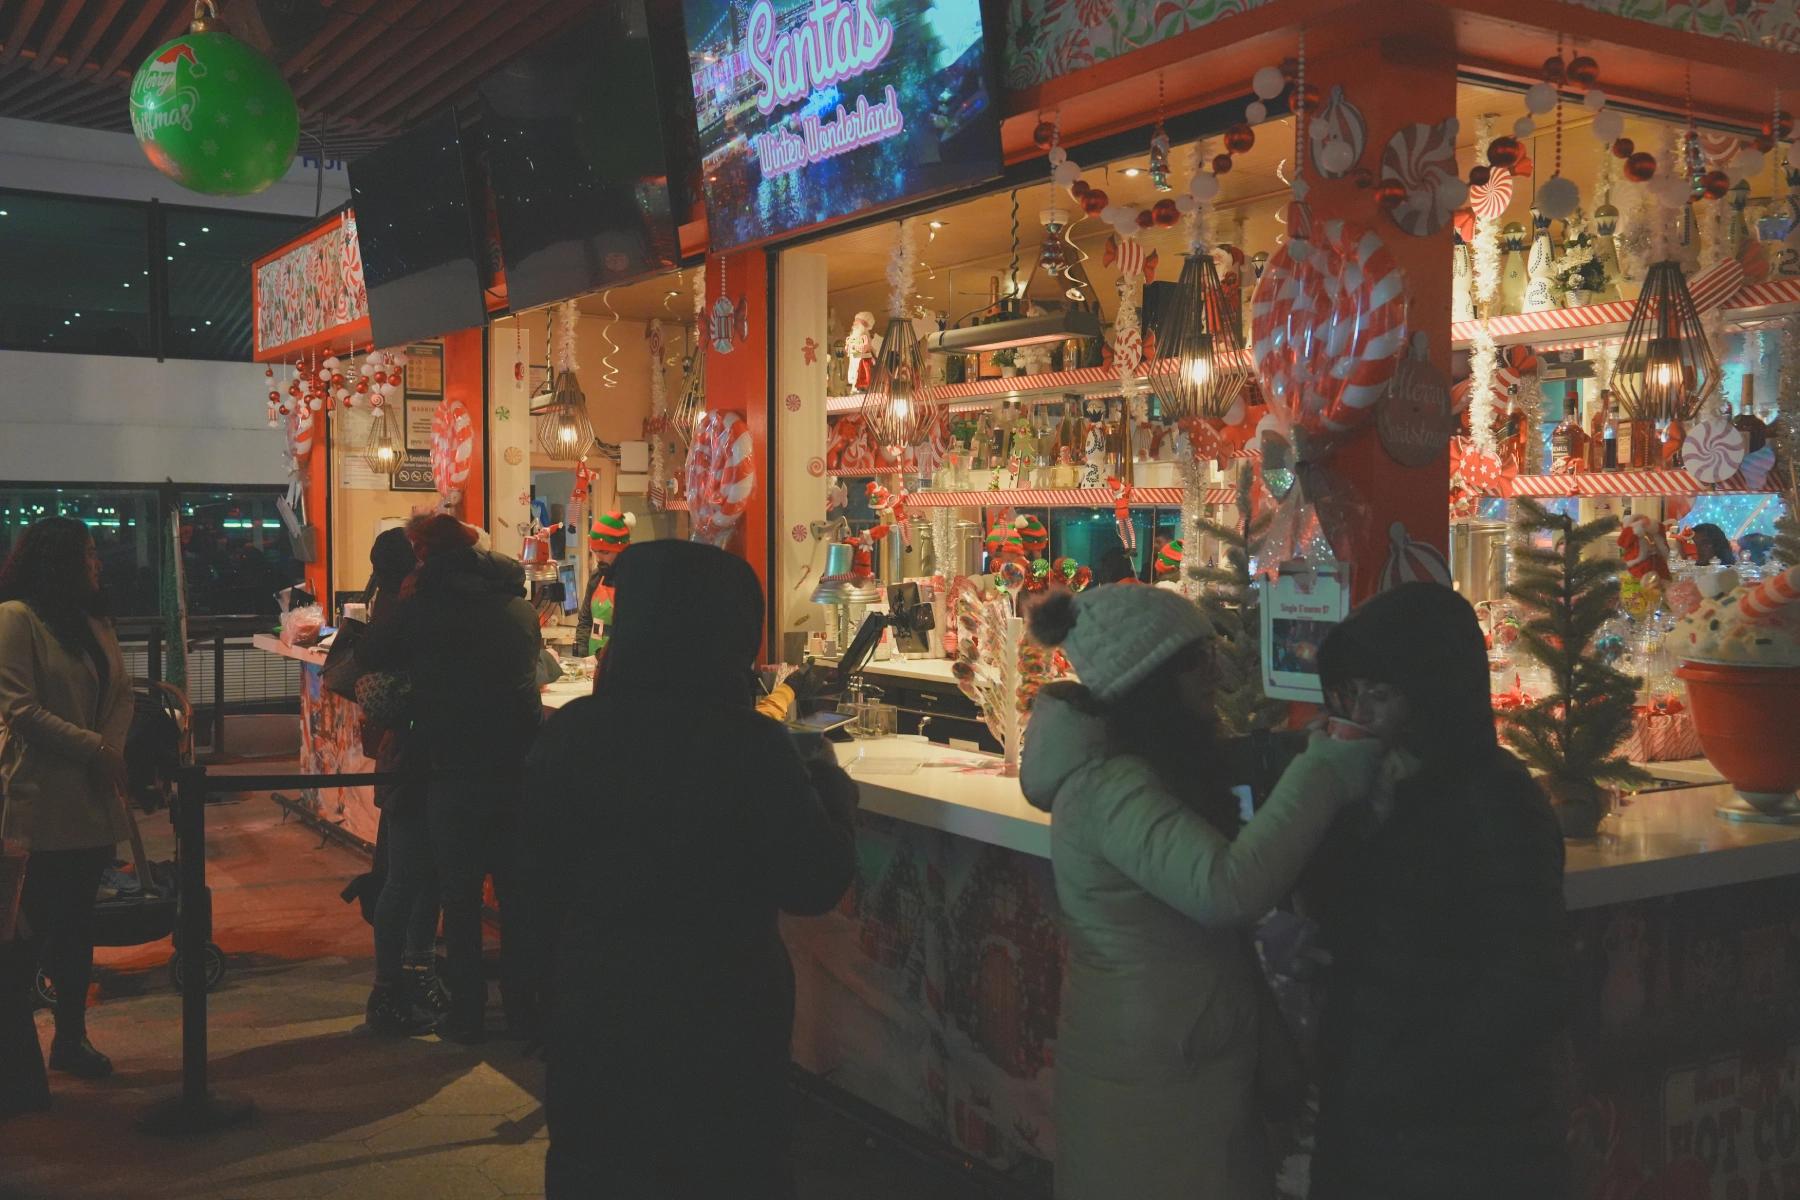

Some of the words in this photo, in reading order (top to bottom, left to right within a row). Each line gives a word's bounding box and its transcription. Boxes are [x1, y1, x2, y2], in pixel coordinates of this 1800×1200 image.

[130, 97, 193, 142] hristmas
[759, 127, 807, 176] Winter
[804, 86, 902, 161] Wonderland
